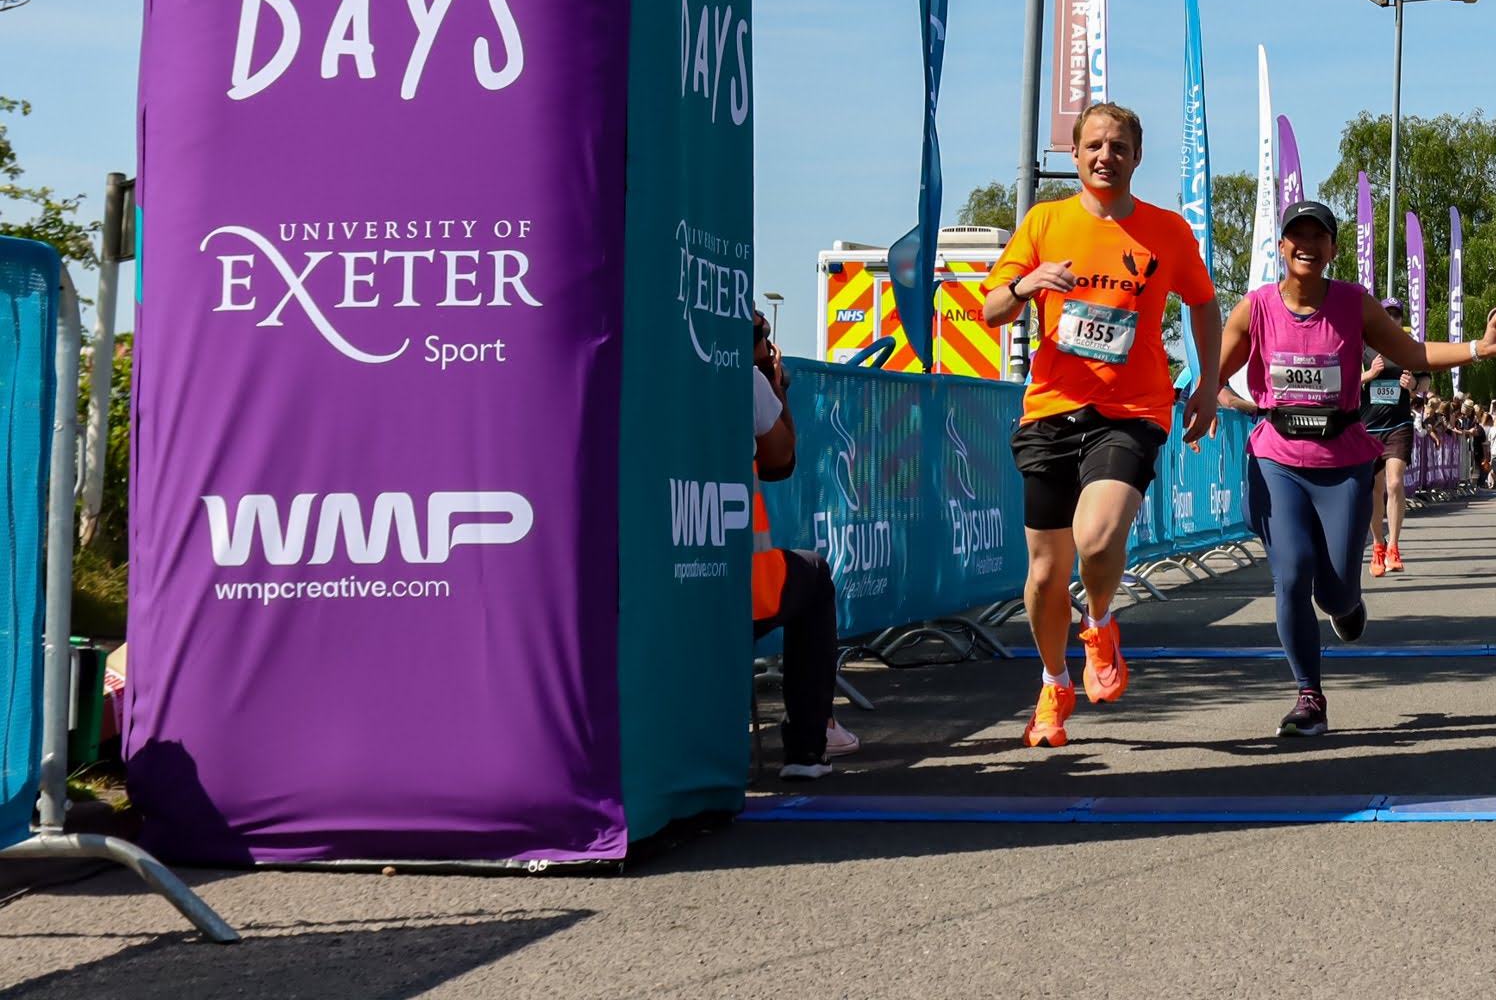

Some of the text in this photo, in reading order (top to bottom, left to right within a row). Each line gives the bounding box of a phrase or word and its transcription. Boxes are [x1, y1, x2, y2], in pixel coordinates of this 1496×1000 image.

[1069, 23, 1088, 103] ARENA
[279, 219, 532, 243] UNIVERSITY OF
[735, 242, 750, 260] OF
[201, 226, 544, 364] EXETER
[676, 219, 752, 363] EXETER
[1076, 274, 1146, 297] offrey
[836, 310, 865, 323] NHS
[1075, 338, 1111, 351] GEOFFREY
[1077, 321, 1116, 344] 1355
[424, 335, 506, 370] Sport
[1285, 369, 1322, 385] 3034
[1376, 387, 1395, 396] 0356
[669, 478, 750, 546] WMP
[200, 491, 535, 567] WMP
[949, 498, 1004, 568] Elysium
[214, 575, 451, 606] wmpcreative.com
[840, 574, 888, 599] Healthcare
